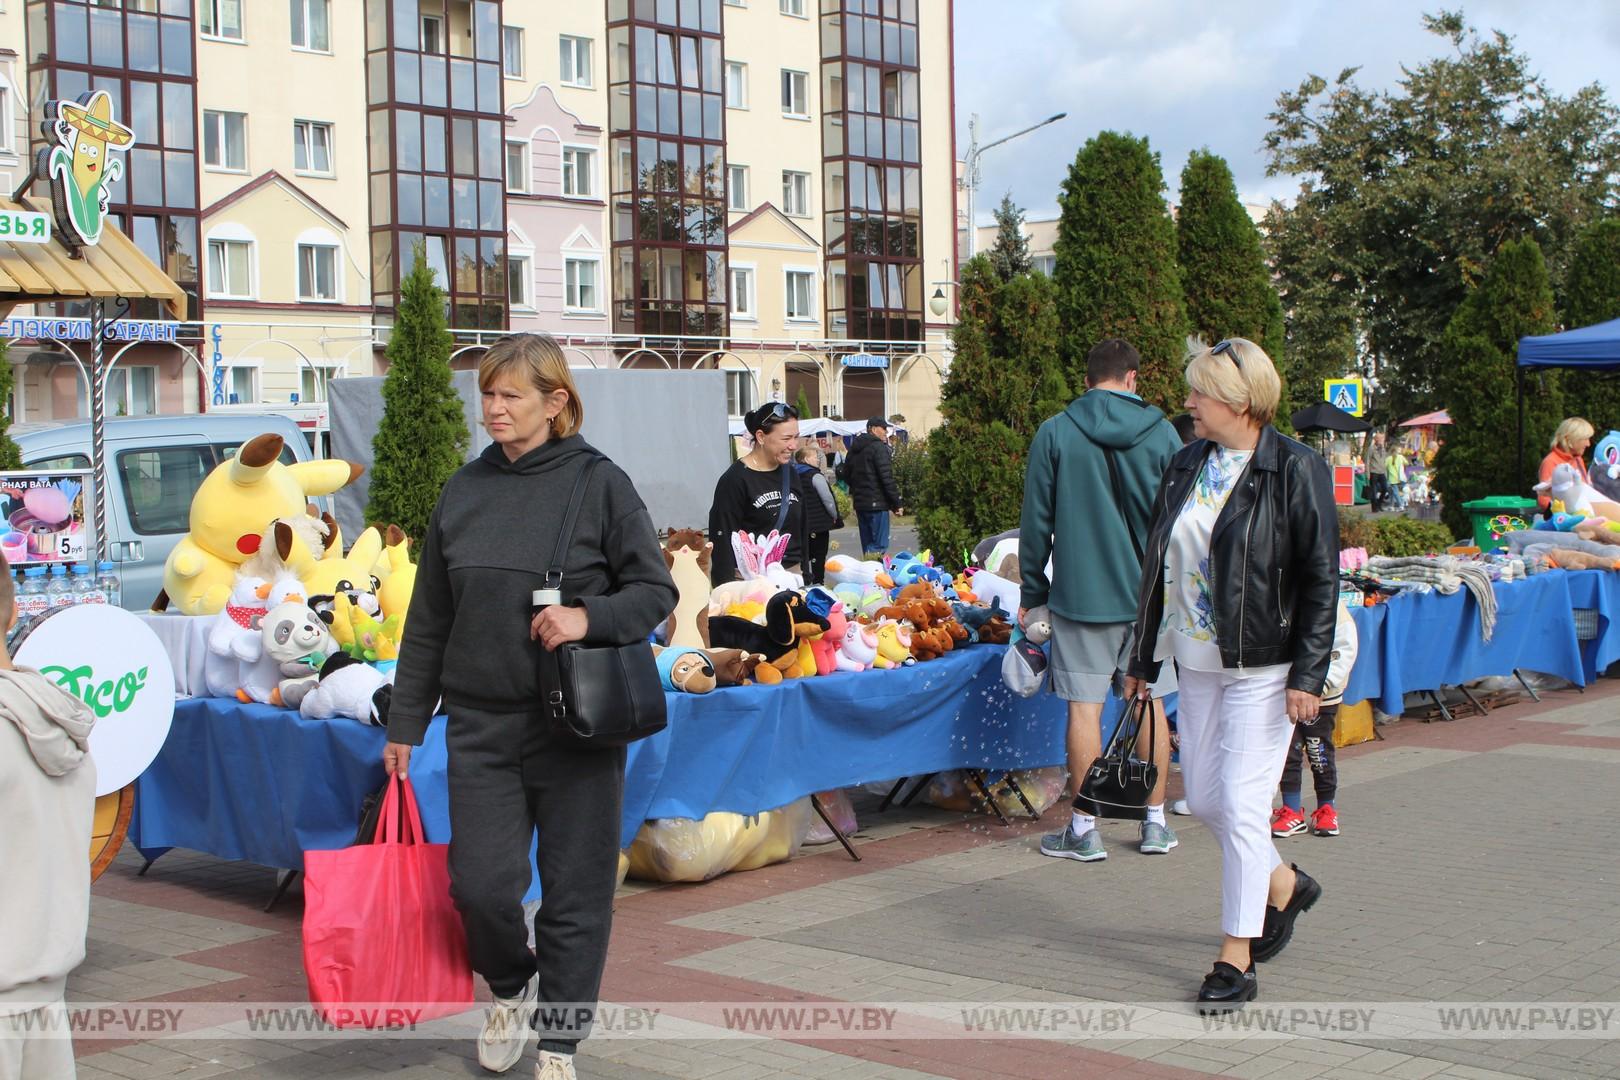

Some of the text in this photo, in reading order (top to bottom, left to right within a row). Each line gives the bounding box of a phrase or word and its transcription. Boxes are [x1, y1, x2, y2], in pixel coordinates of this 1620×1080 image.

[0, 481, 27, 489] РНАЯ
[61, 538, 83, 554] 5 руб
